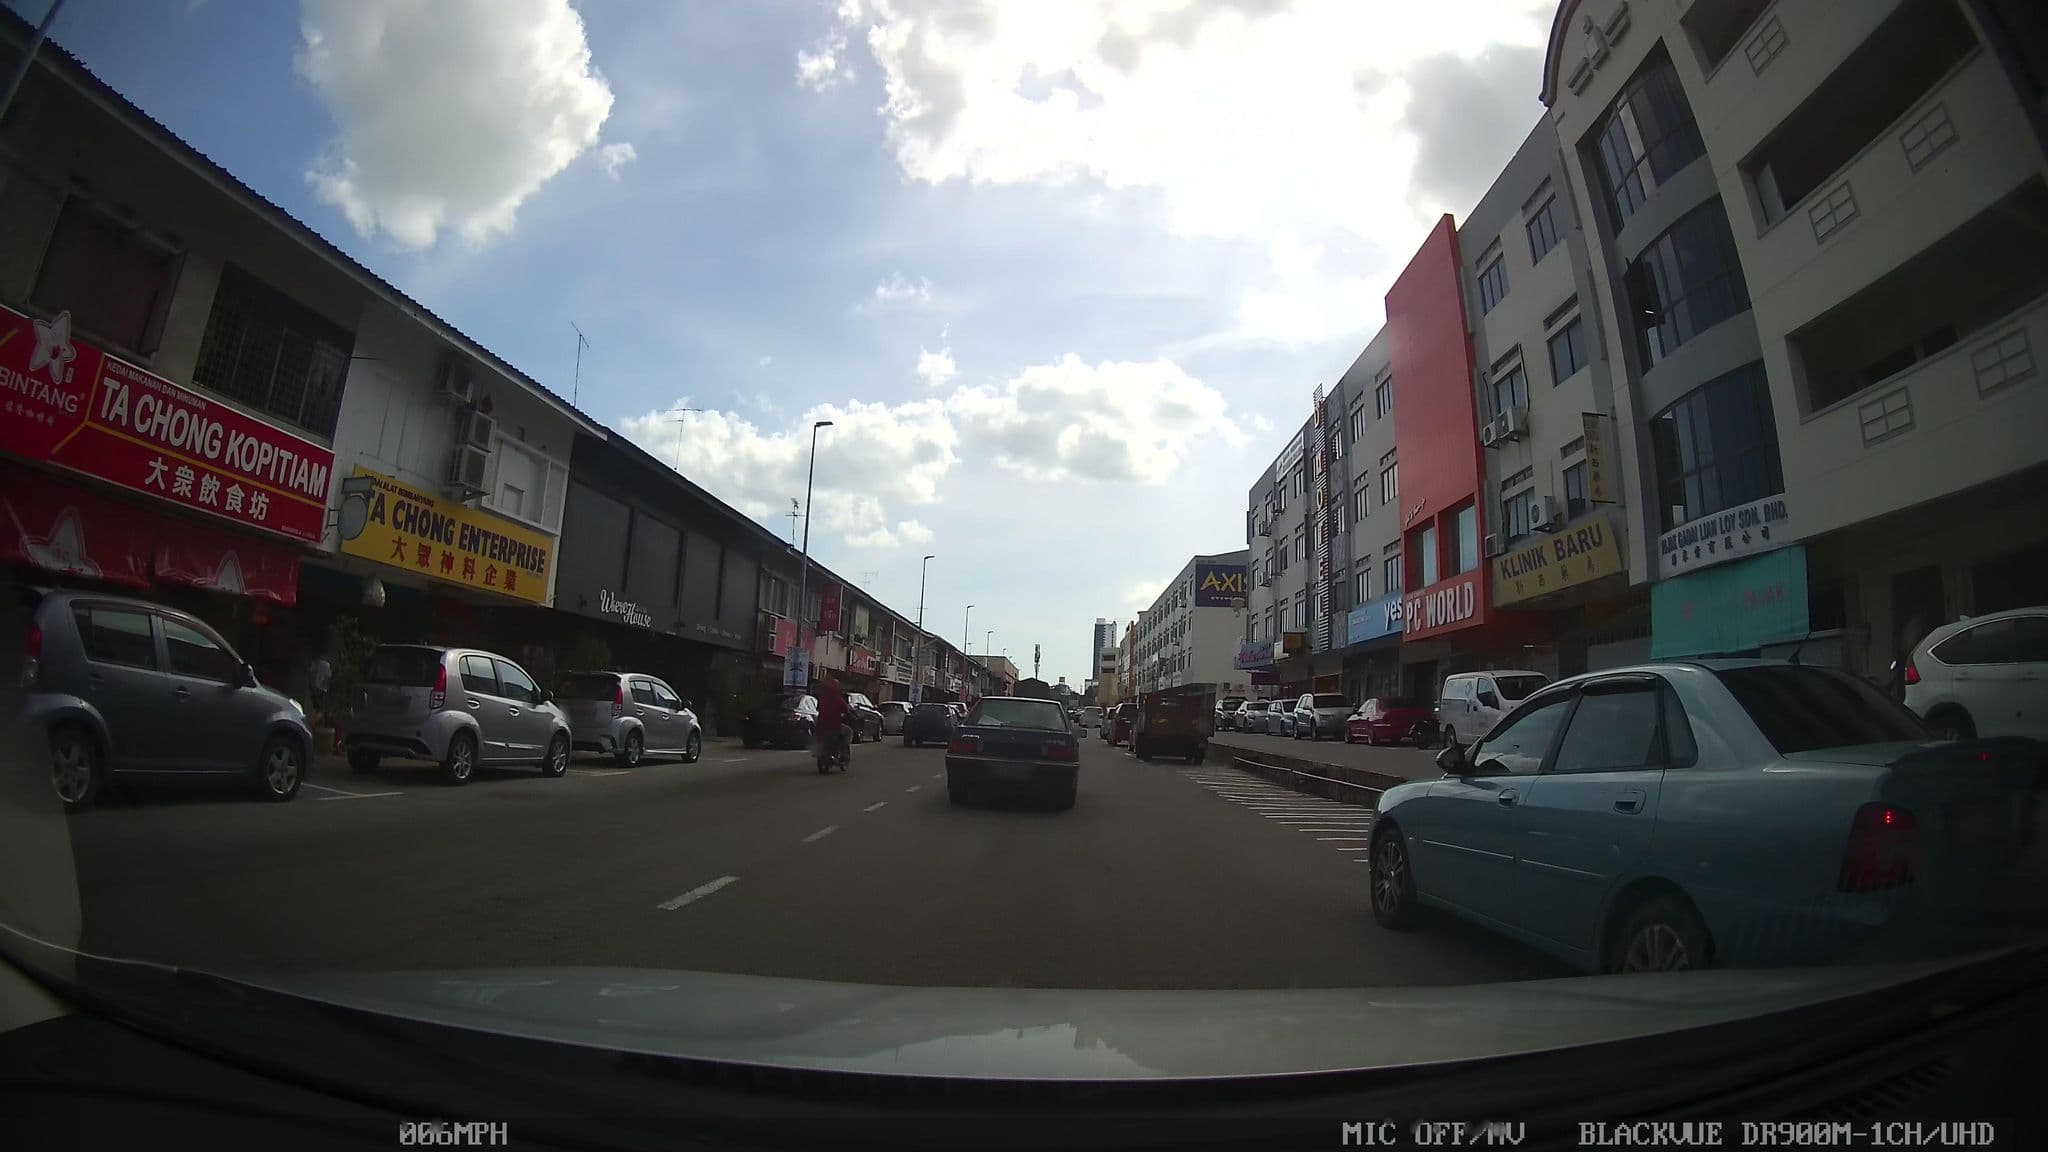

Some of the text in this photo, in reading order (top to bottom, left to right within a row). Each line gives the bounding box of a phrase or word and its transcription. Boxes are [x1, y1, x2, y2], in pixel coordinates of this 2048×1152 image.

[0, 366, 79, 414] BINTANG
[107, 361, 128, 377] KEDAI
[128, 371, 162, 392] MAKANAN
[162, 385, 176, 398] DAN
[100, 377, 128, 426] TA
[134, 394, 223, 459] CHONG
[224, 429, 327, 498] KOPITIAM
[392, 499, 456, 546] CHONG
[458, 522, 547, 575] ENTERPRISE
[1500, 545, 1548, 580] KLINIK
[1552, 523, 1603, 562] BARU
[1406, 581, 1474, 634] PC WORLD
